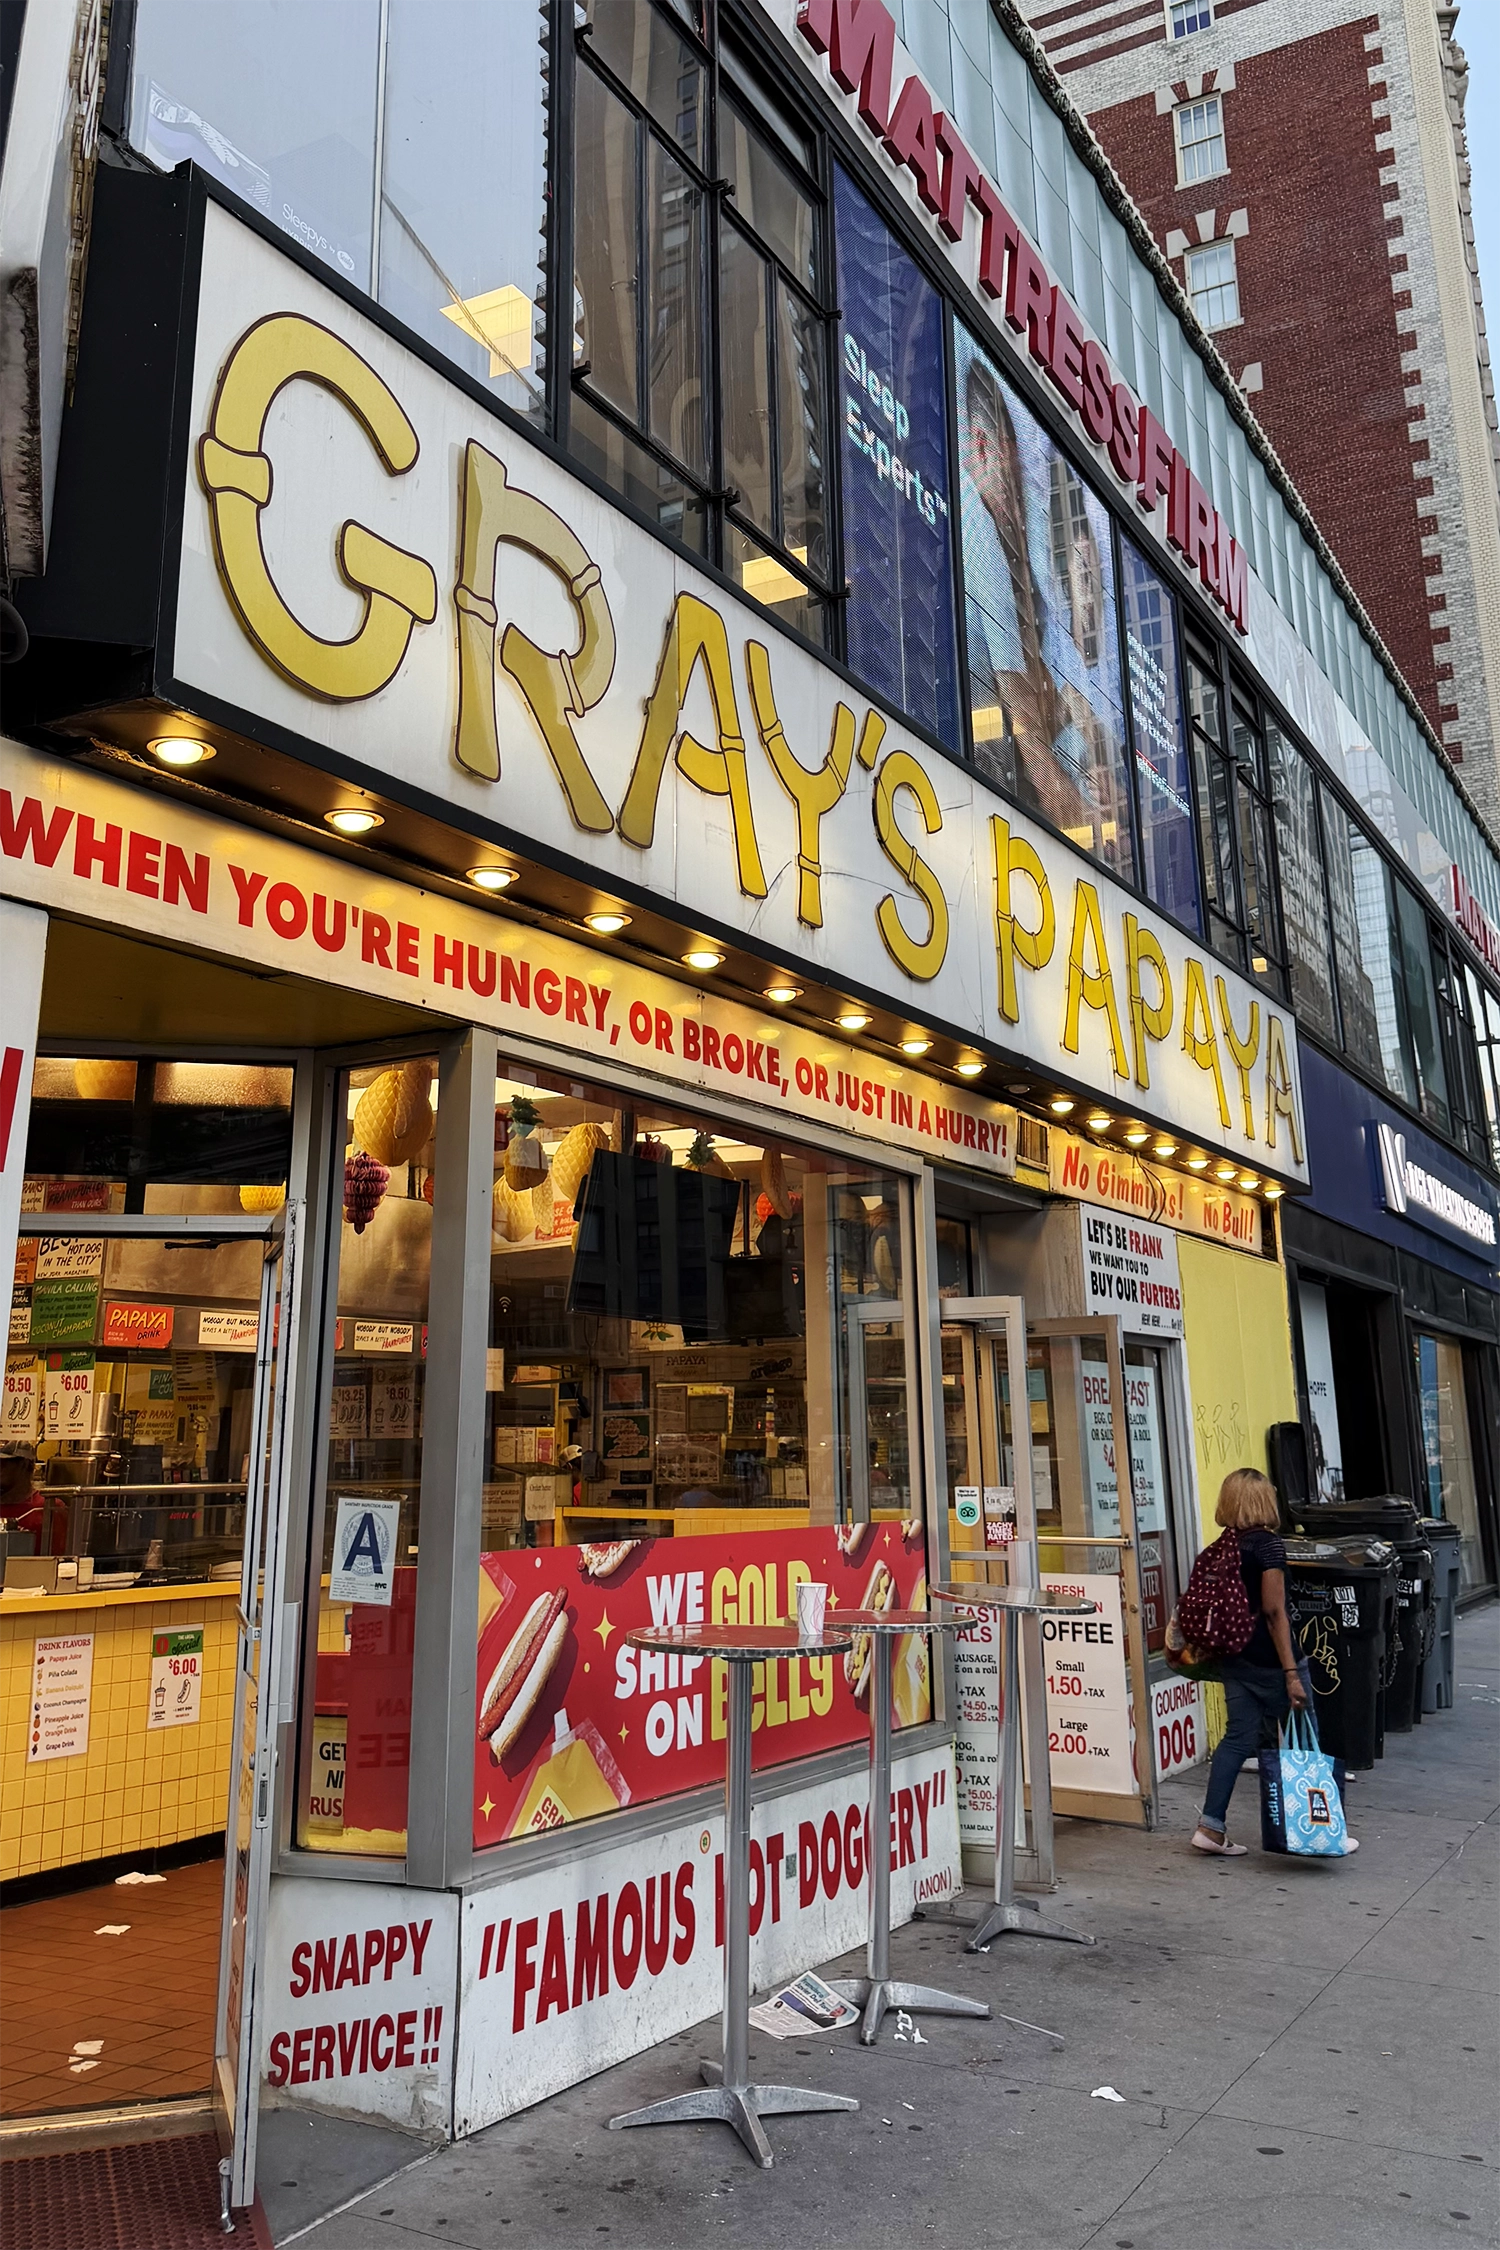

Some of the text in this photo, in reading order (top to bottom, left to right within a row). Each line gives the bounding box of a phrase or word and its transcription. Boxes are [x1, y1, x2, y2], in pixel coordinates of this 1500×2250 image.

[799, 0, 1249, 636] MATTRESS FIRM
[844, 333, 909, 440] Sleep
[199, 310, 1303, 1165] GRAY'S PAPAYA
[0, 788, 1008, 1158] WHEN YOU'RE HUNGRY, OR BROKE, OR JUST IN A HURRY!
[1062, 1145, 1090, 1192] No
[1203, 1201, 1254, 1243] No Bull!
[1087, 1217, 1164, 1260] LET'S BE FRANK
[67, 1243, 102, 1255] HOT DOG
[43, 1258, 52, 1267] IN
[56, 1256, 72, 1267] THE
[1089, 1250, 1149, 1276] WE WANT YOU TO
[65, 1282, 98, 1293] CALLING
[1090, 1271, 1181, 1311] BUY OUR FURTERS
[109, 1308, 167, 1330] PAPAYA
[202, 1316, 237, 1326] NOBODY BUT
[137, 1330, 160, 1341] DRINK
[356, 1324, 411, 1335] NOBODY BUT NOBODY
[8, 1356, 36, 1374] Special
[64, 1353, 93, 1372] Special
[666, 1356, 706, 1366] PAPAYA
[4, 1375, 31, 1392] $8.50
[61, 1374, 88, 1391] $6.00
[338, 1388, 365, 1402] $13.25
[386, 1387, 410, 1400] $8.50
[342, 1512, 383, 1574] A
[646, 1571, 704, 1627] WE
[38, 1638, 91, 1651] DRINK FLAVORS
[172, 1635, 201, 1656] Special
[49, 1653, 82, 1663] Papaya Juice
[60, 1669, 77, 1677] Colada
[168, 1657, 197, 1676] $6.00
[614, 1643, 704, 1700] SHIP
[982, 1665, 998, 1674] roll
[1055, 1660, 1085, 1673] Small
[959, 1686, 986, 1697] +TAX
[1083, 1688, 1106, 1698] +TAX
[62, 1698, 87, 1707] Champagne
[963, 1700, 987, 1711] $4.50
[44, 1712, 84, 1724] Pineapple Juice
[645, 1693, 703, 1757] ON
[963, 1712, 987, 1722] $5.25
[1060, 1718, 1088, 1733] Large
[45, 1730, 63, 1738] Orange
[45, 1740, 75, 1751] Grape Drink
[1048, 1733, 1110, 1757] 2.00 +TAX
[1159, 1714, 1195, 1771] DOG
[964, 1775, 990, 1786] +TAX
[968, 1789, 992, 1800] $5.00
[968, 1800, 992, 1811] $5.75
[1268, 1782, 1280, 1826] aldi.us
[913, 1866, 952, 1904] (ANON)
[290, 1918, 433, 1998] SNAPPY
[268, 2006, 443, 2088] SERVICE!!
